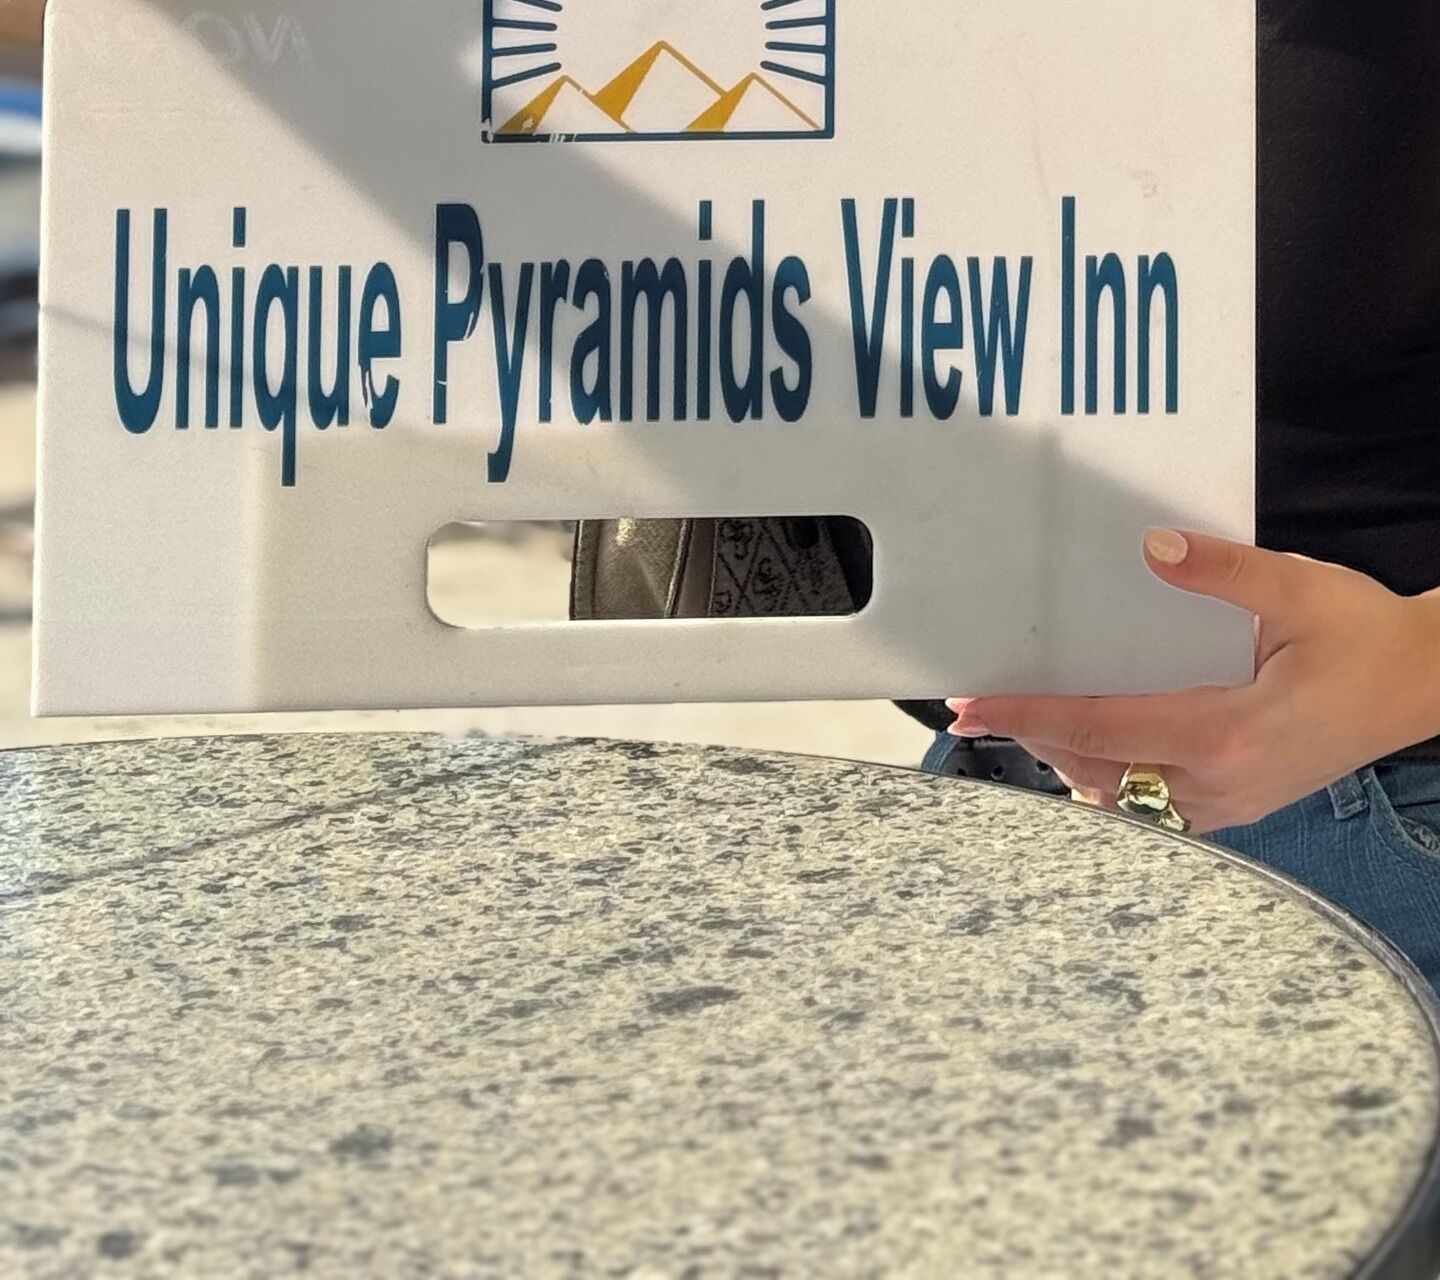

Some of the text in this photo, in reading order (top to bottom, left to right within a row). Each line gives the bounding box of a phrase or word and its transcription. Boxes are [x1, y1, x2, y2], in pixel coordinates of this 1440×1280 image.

[113, 195, 1178, 486] Unique Pyramids View Inn
